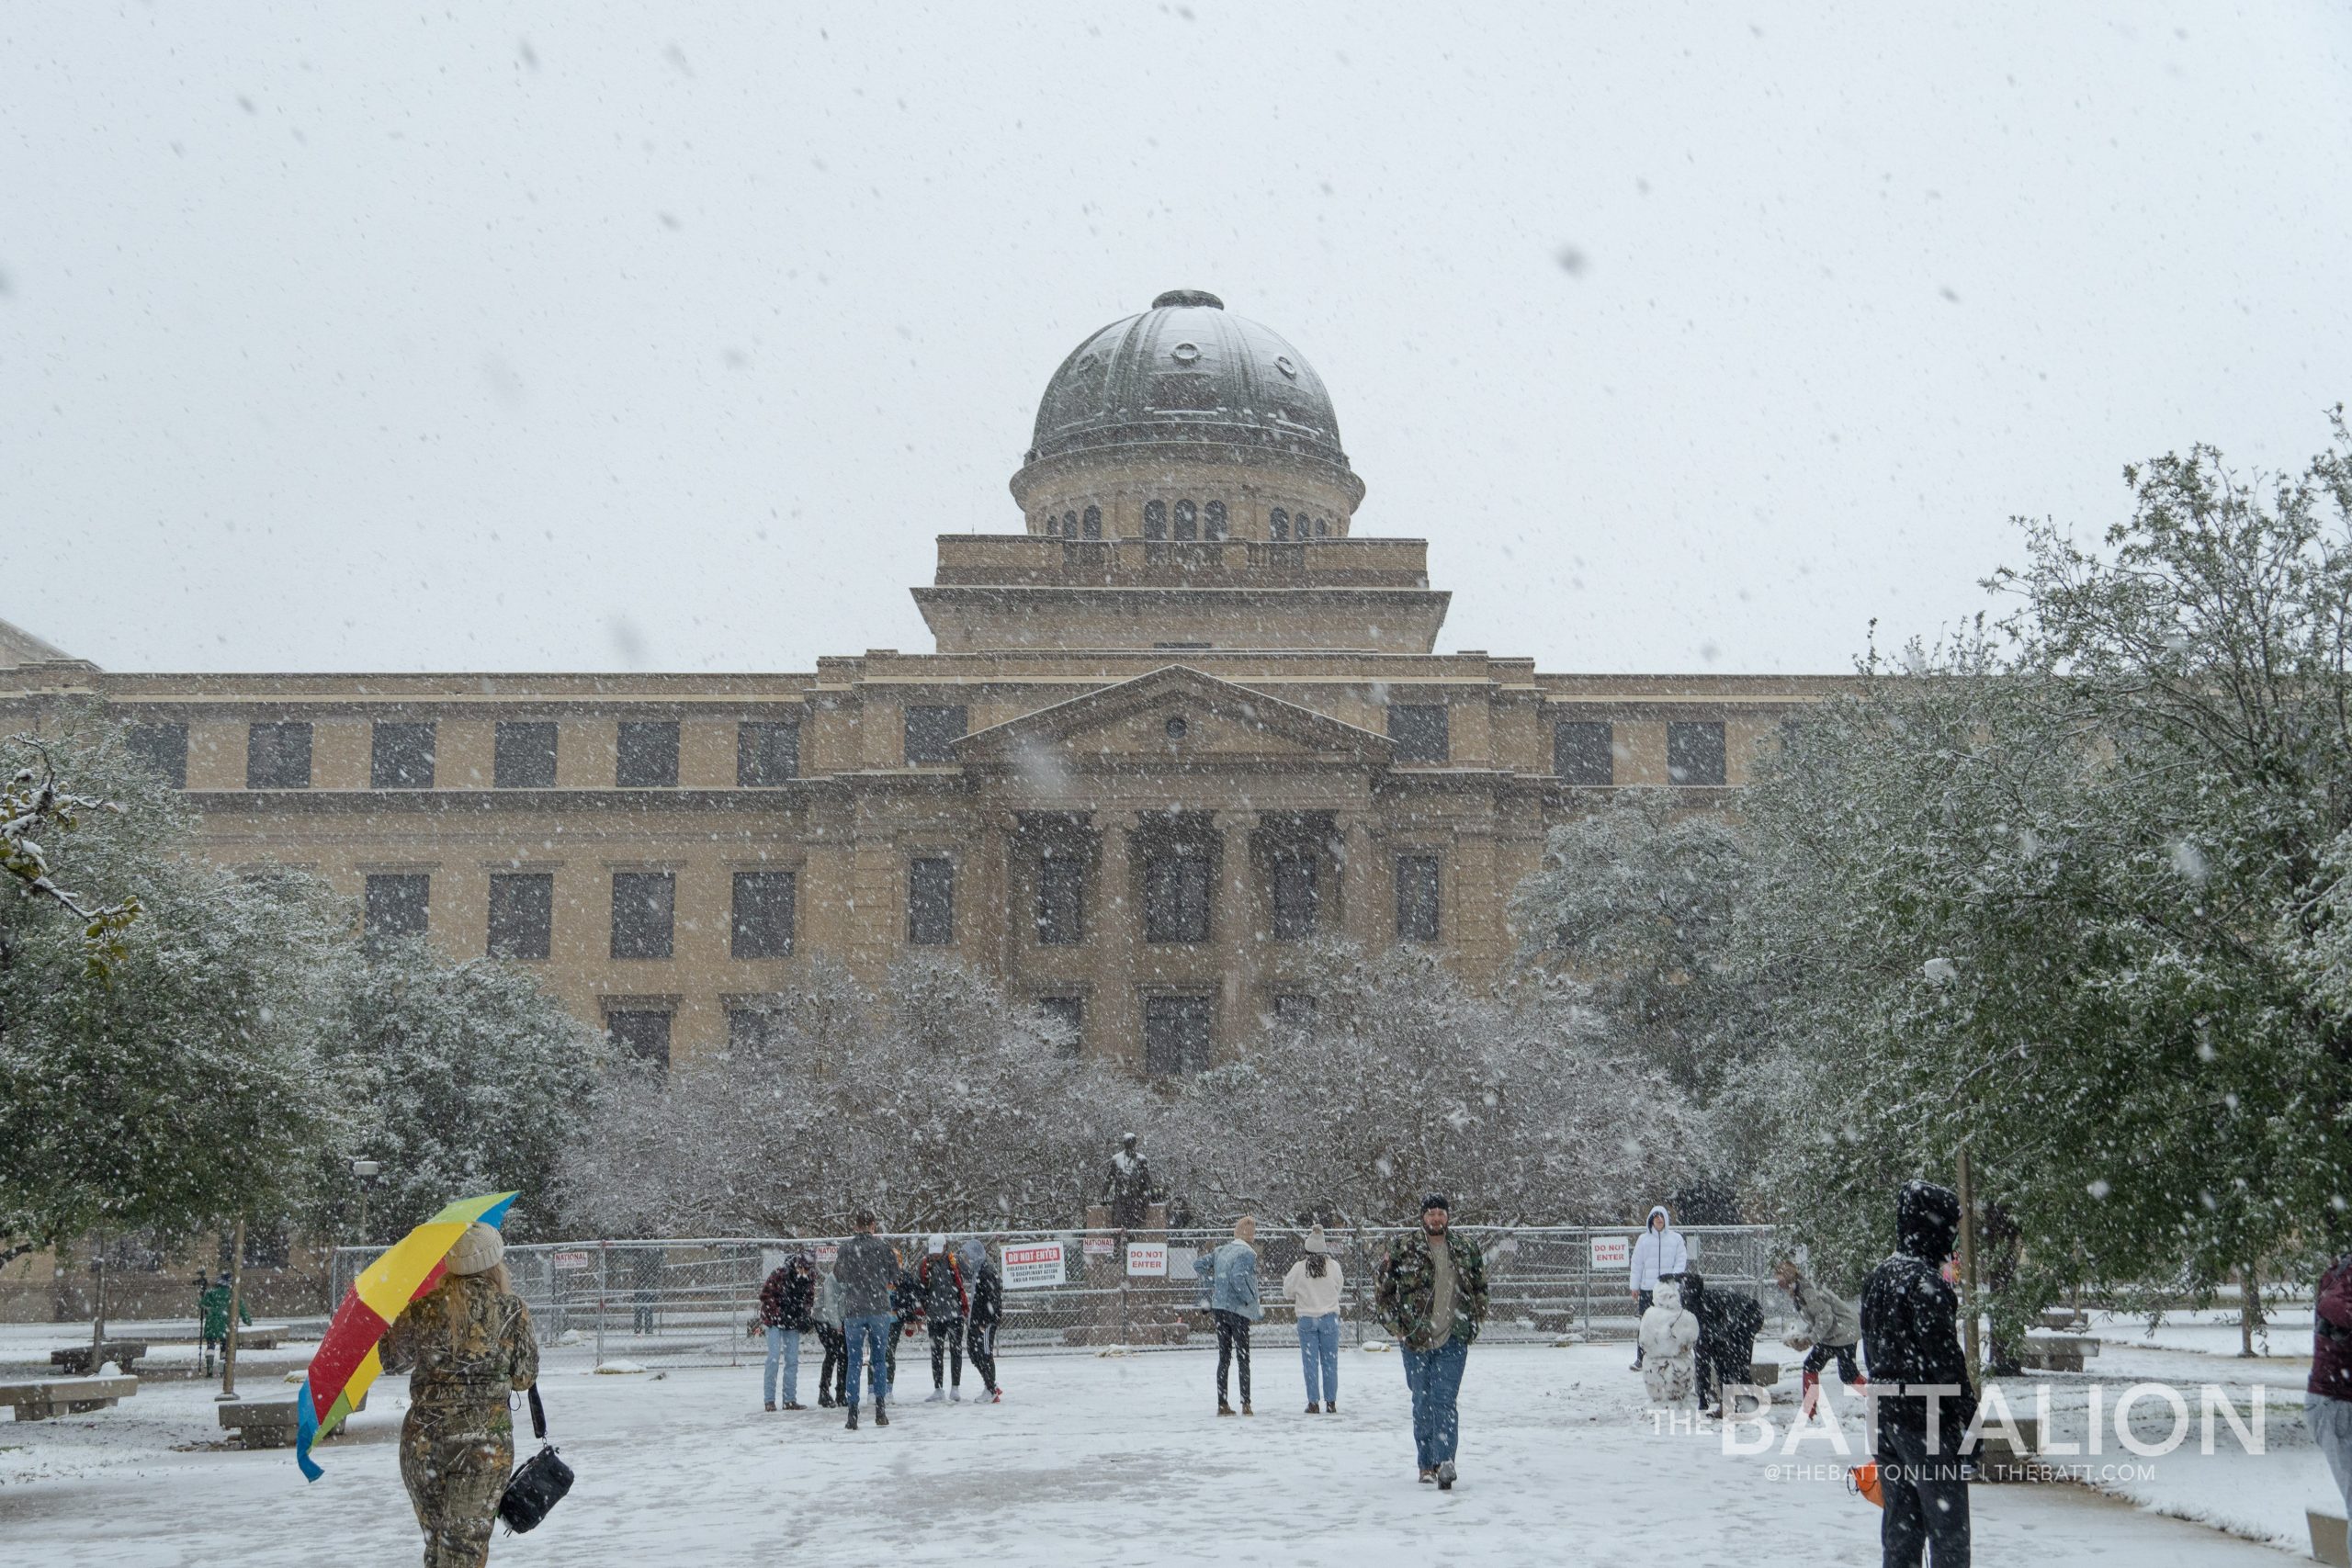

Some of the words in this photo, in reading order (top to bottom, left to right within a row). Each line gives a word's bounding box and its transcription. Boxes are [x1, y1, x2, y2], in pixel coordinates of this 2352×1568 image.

[555, 1252, 586, 1260] NATIONAL
[1008, 1253, 1019, 1263] DO
[1020, 1251, 1035, 1262] NOT
[1036, 1248, 1057, 1260] ENTER
